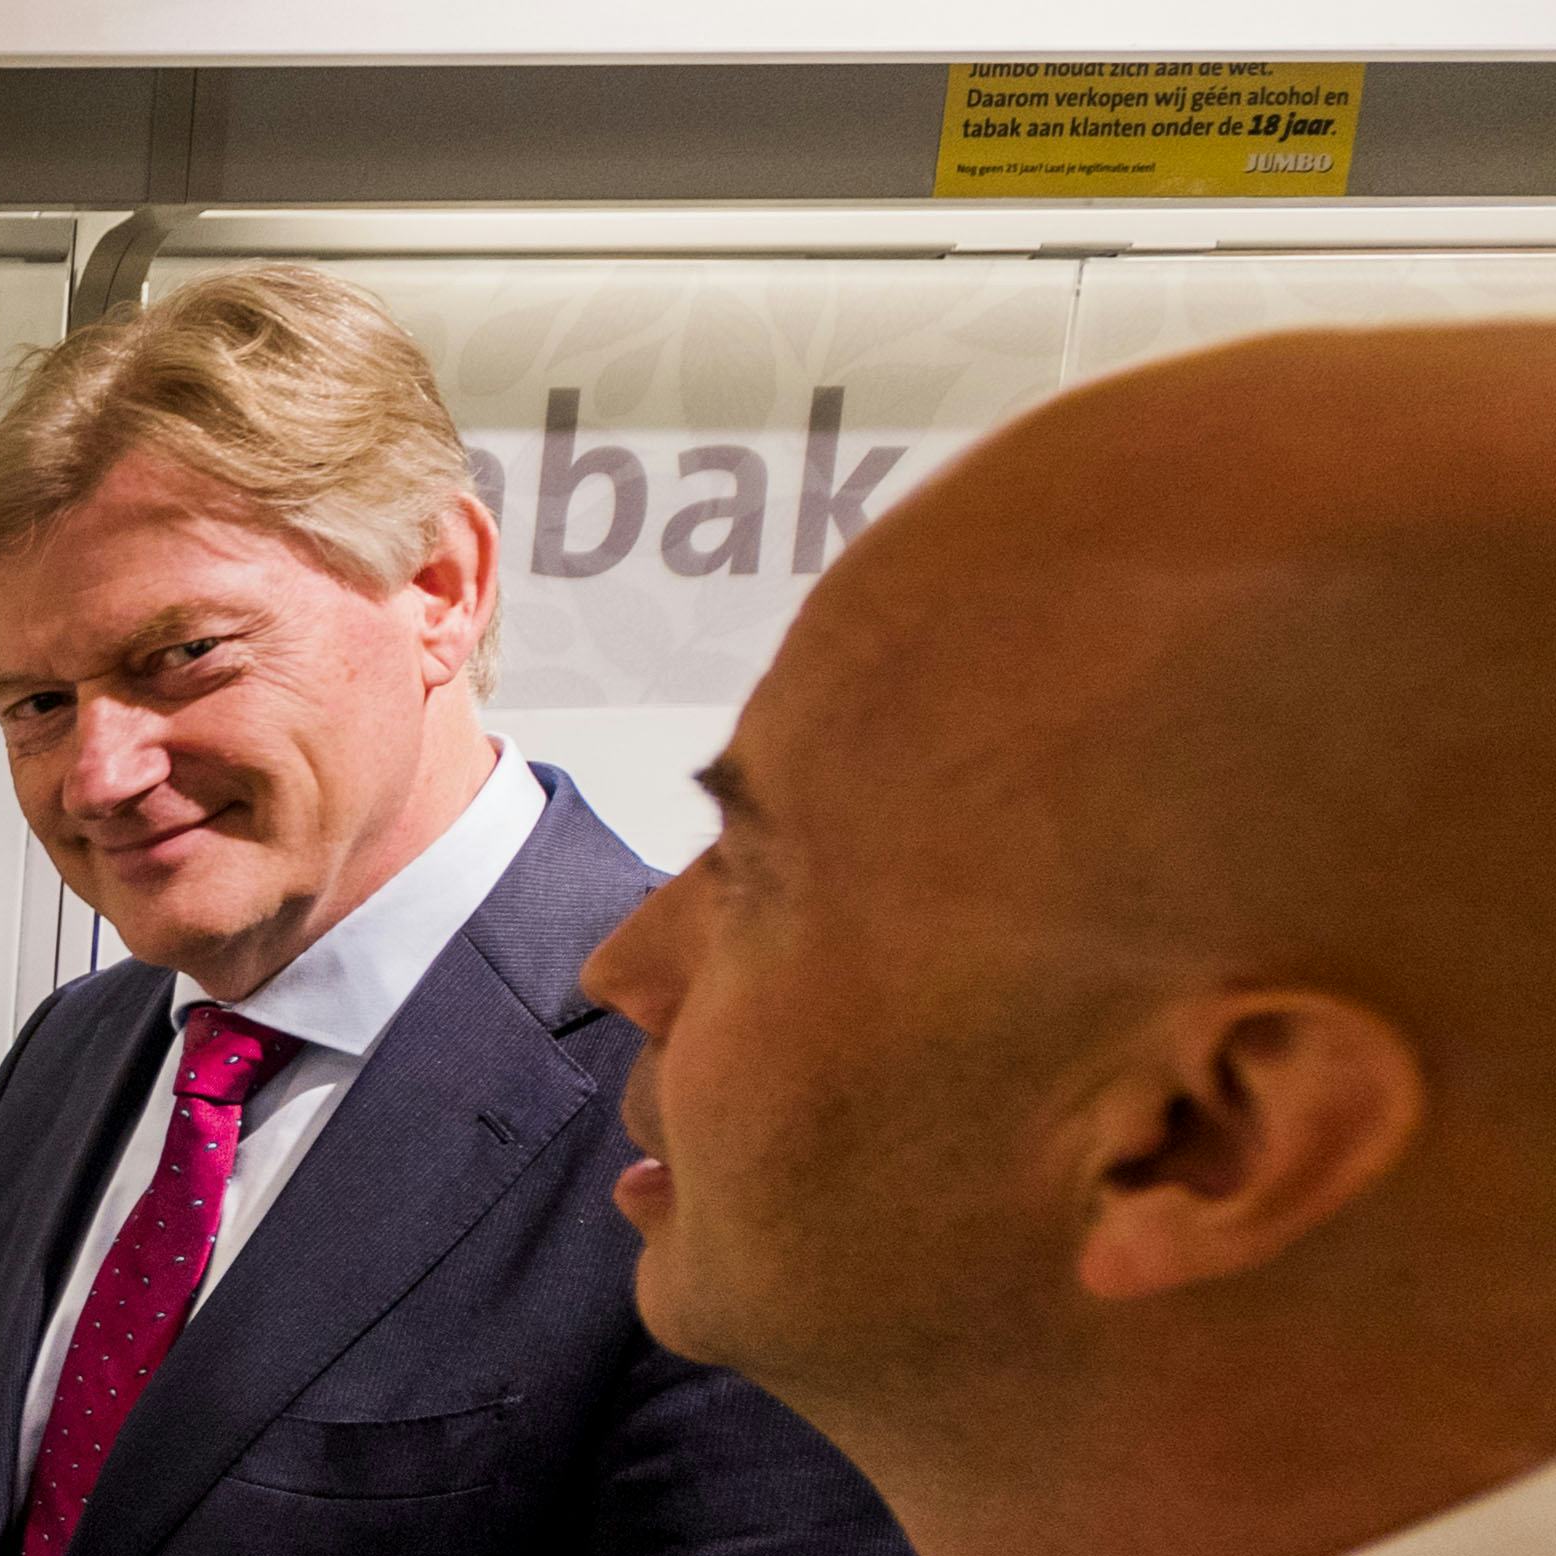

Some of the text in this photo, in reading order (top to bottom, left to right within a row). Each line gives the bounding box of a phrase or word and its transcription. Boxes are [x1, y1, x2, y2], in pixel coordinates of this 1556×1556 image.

[969, 62, 1273, 78] Jumbo houdt zich aan de wet.
[967, 85, 1349, 112] Daarom verkopen wij géén alcohol en
[962, 111, 1337, 143] tabak aan klanten onder de 18 jaar.
[1243, 152, 1335, 175] JUMBO
